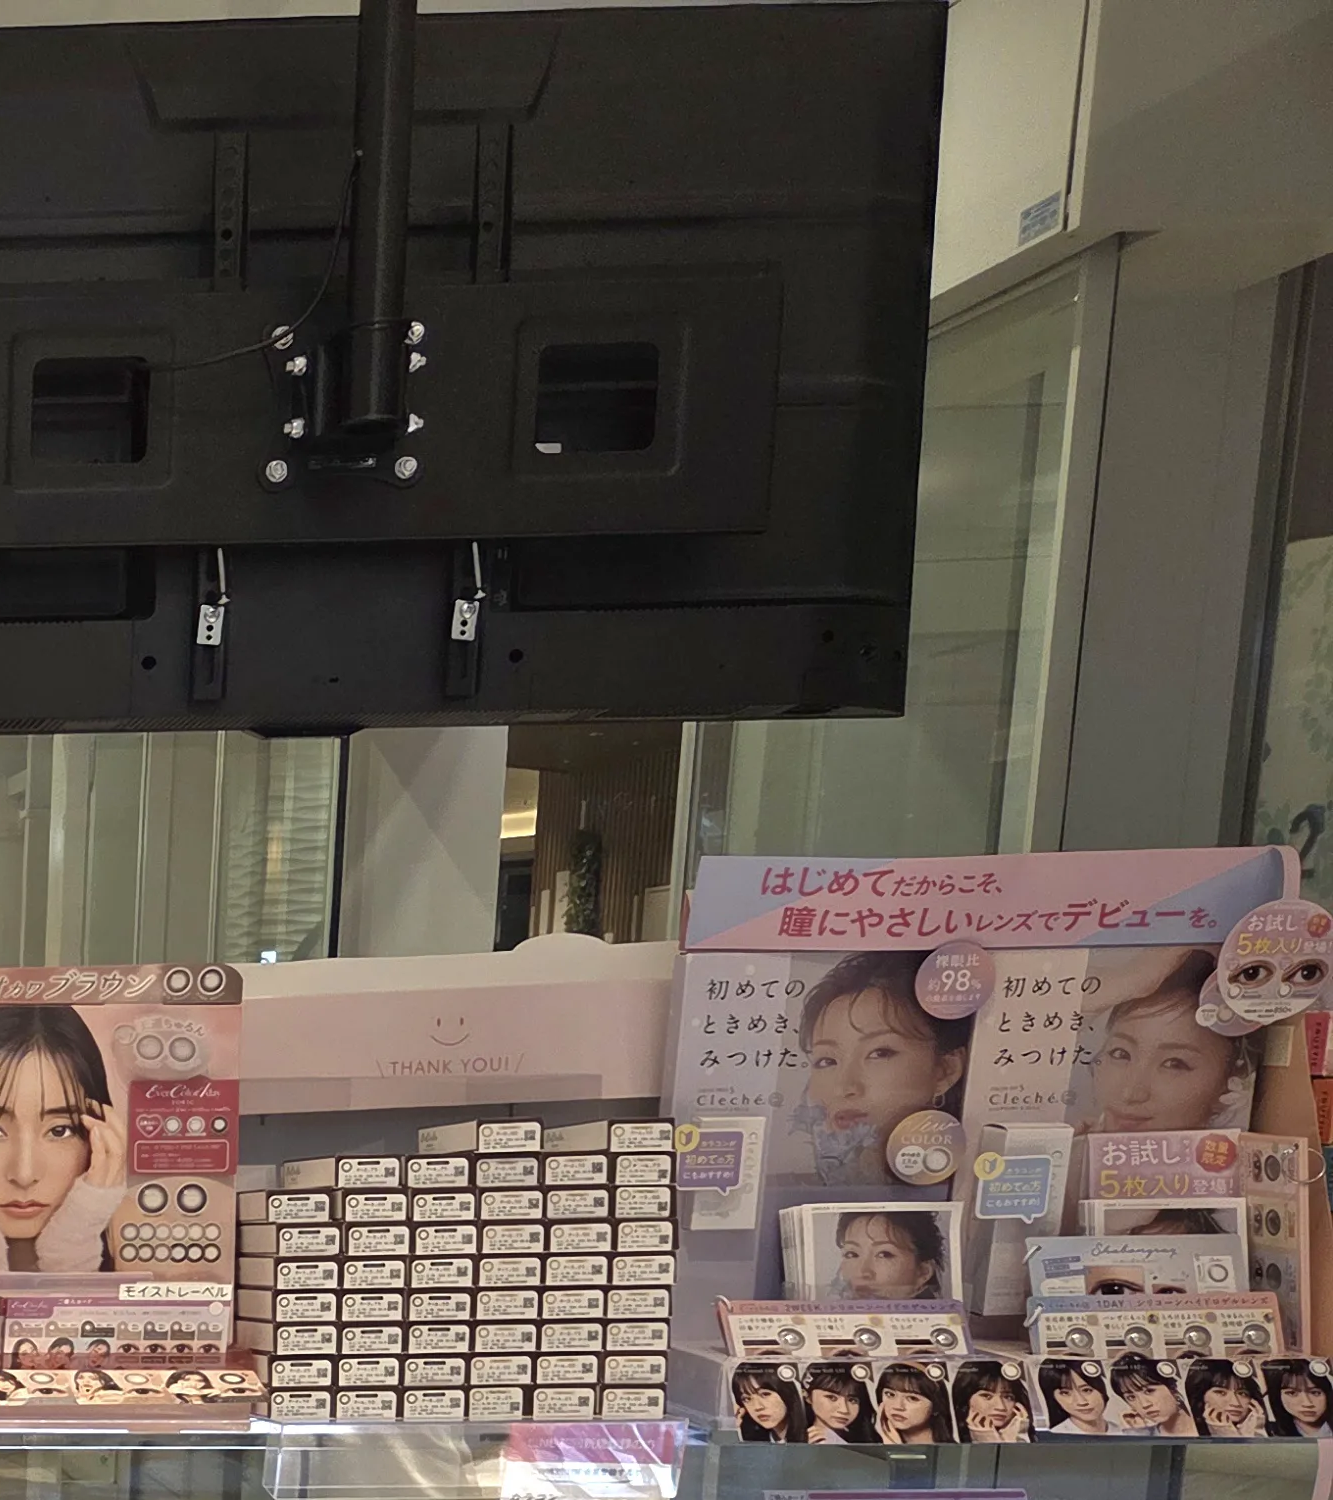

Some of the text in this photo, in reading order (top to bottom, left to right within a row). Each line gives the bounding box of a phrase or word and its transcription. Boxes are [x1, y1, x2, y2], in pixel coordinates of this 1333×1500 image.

[761, 865, 1004, 899] はじめてだからこそ、
[778, 899, 1220, 939] 瞳にやさしいレンズでデビューを。
[1248, 914, 1298, 932] お試し
[1236, 932, 1303, 956] 5枚入り
[706, 977, 806, 1001] 初めての
[1002, 974, 1103, 998] 初めての
[701, 1012, 801, 1036] ときめき、
[996, 1009, 1099, 1034] ときめき、
[390, 1057, 511, 1075] THANK YOU!
[699, 1048, 812, 1070] みつけた。
[993, 1046, 1105, 1069] みつけた。
[901, 1134, 953, 1145] COLOR
[685, 1153, 735, 1166] 初めての方
[1102, 1140, 1181, 1165] お試し
[682, 1170, 734, 1180] にもおすすめ!
[1099, 1171, 1235, 1198] 5枚入り 登場!
[988, 1180, 1042, 1194] 初めての方
[123, 1285, 229, 1299] モイストレーベル
[1096, 1299, 1125, 1309] 1DAY
